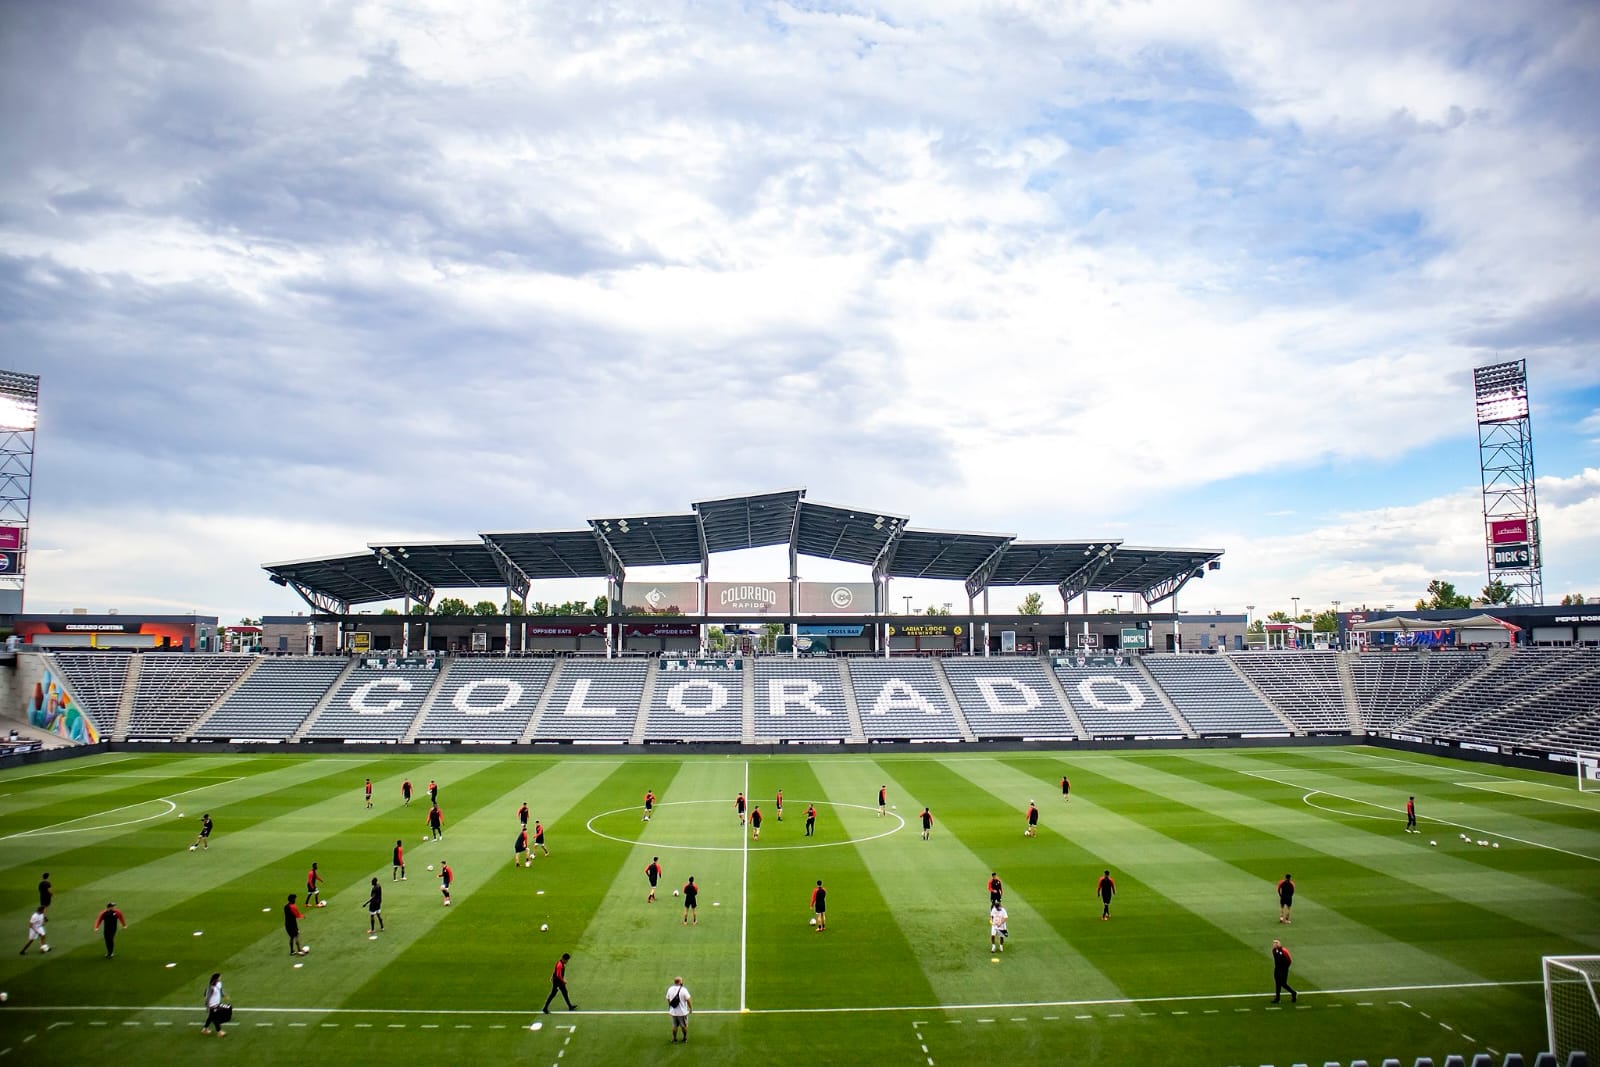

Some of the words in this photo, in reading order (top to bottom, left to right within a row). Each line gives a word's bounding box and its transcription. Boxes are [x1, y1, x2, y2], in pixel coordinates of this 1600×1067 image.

[1495, 550, 1528, 563] DICK'S
[720, 585, 776, 605] COLORADO
[1123, 635, 1145, 643] DICK'S
[348, 676, 1146, 716] COLORADO
